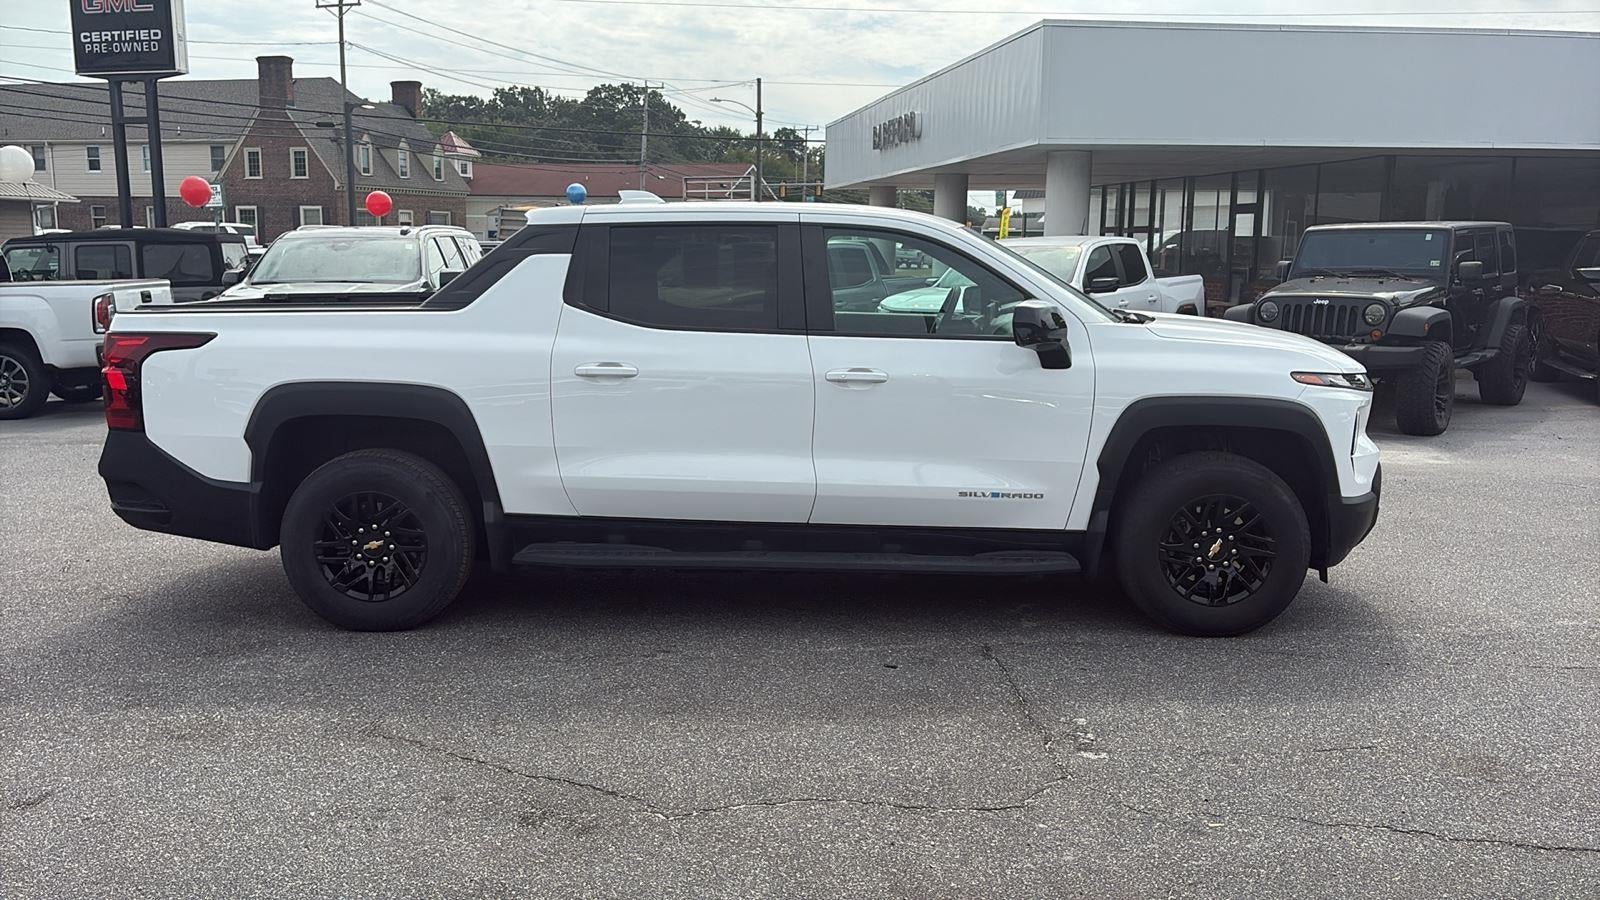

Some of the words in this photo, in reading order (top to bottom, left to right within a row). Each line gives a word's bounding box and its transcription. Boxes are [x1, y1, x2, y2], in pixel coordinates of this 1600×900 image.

[80, 29, 162, 42] CERTIFIED
[85, 41, 159, 53] PRE-OWNED
[1313, 298, 1329, 306] Jeep
[958, 491, 1044, 499] SILVERADO
